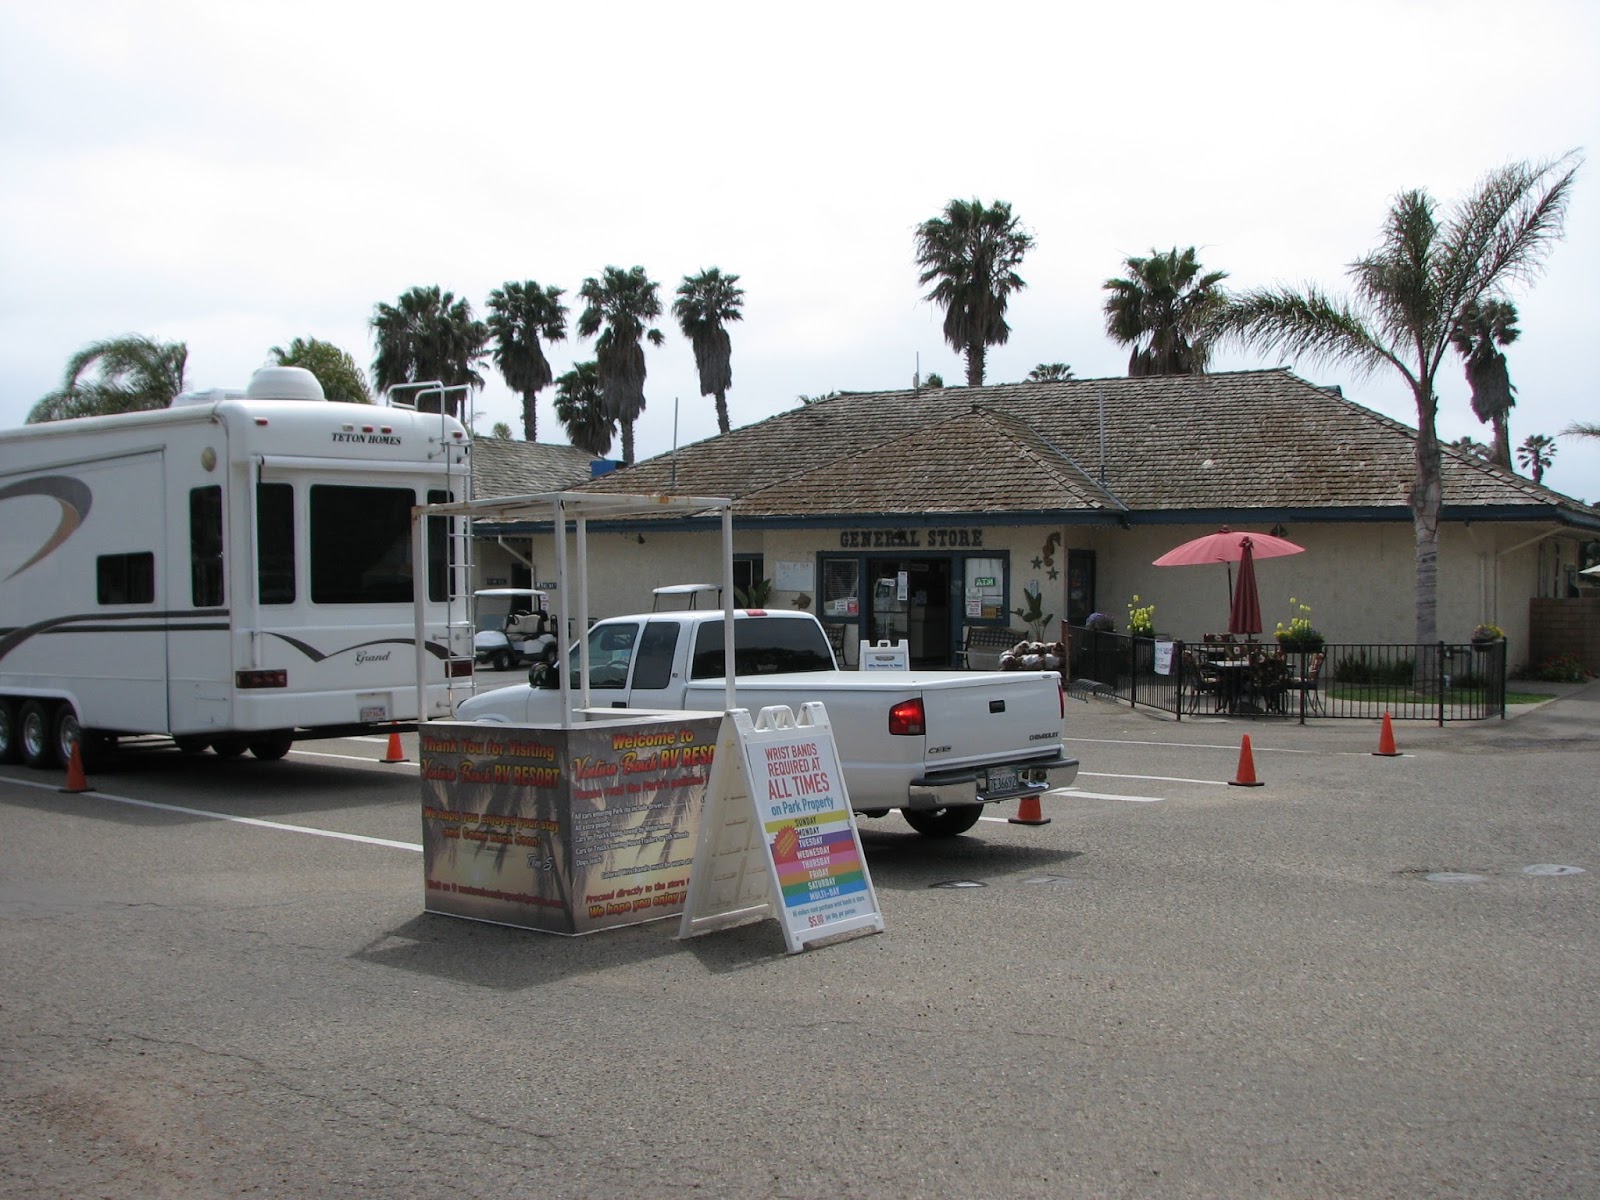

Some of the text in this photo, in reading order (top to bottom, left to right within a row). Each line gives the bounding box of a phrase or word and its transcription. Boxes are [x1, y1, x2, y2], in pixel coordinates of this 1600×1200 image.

[331, 432, 402, 446] TETON HOMES
[840, 528, 983, 548] GENERAL STORE
[976, 578, 994, 587] ATM
[355, 650, 391, 666] Grand
[422, 735, 556, 761] Thank You for Visiting
[612, 729, 694, 751] Welcome to
[764, 742, 817, 761] WRIST BANDS
[574, 755, 618, 781] Ventura
[660, 748, 680, 770] RV
[681, 743, 717, 767] RESO
[767, 756, 821, 778] REQUIRED AT
[494, 763, 511, 785] RV
[513, 764, 561, 788] RESORT
[768, 772, 830, 800] ALL TIMES
[771, 795, 834, 816] on Park Property
[437, 808, 460, 822] hope
[462, 810, 480, 825] you
[794, 815, 817, 828] SUNDAY
[799, 836, 823, 848] TUESDAY
[796, 845, 831, 860] WEDNESDAY
[801, 856, 831, 870] THURSDAY
[808, 867, 829, 880] FRIDAY
[616, 885, 643, 898] directly
[645, 883, 653, 892] to
[654, 881, 665, 891] the
[807, 876, 836, 891] SATURDAY
[808, 886, 841, 901] MULTI-DAY
[588, 905, 605, 919] We
[606, 901, 631, 917] hope
[632, 897, 652, 913] you
[652, 891, 679, 907] enjoy
